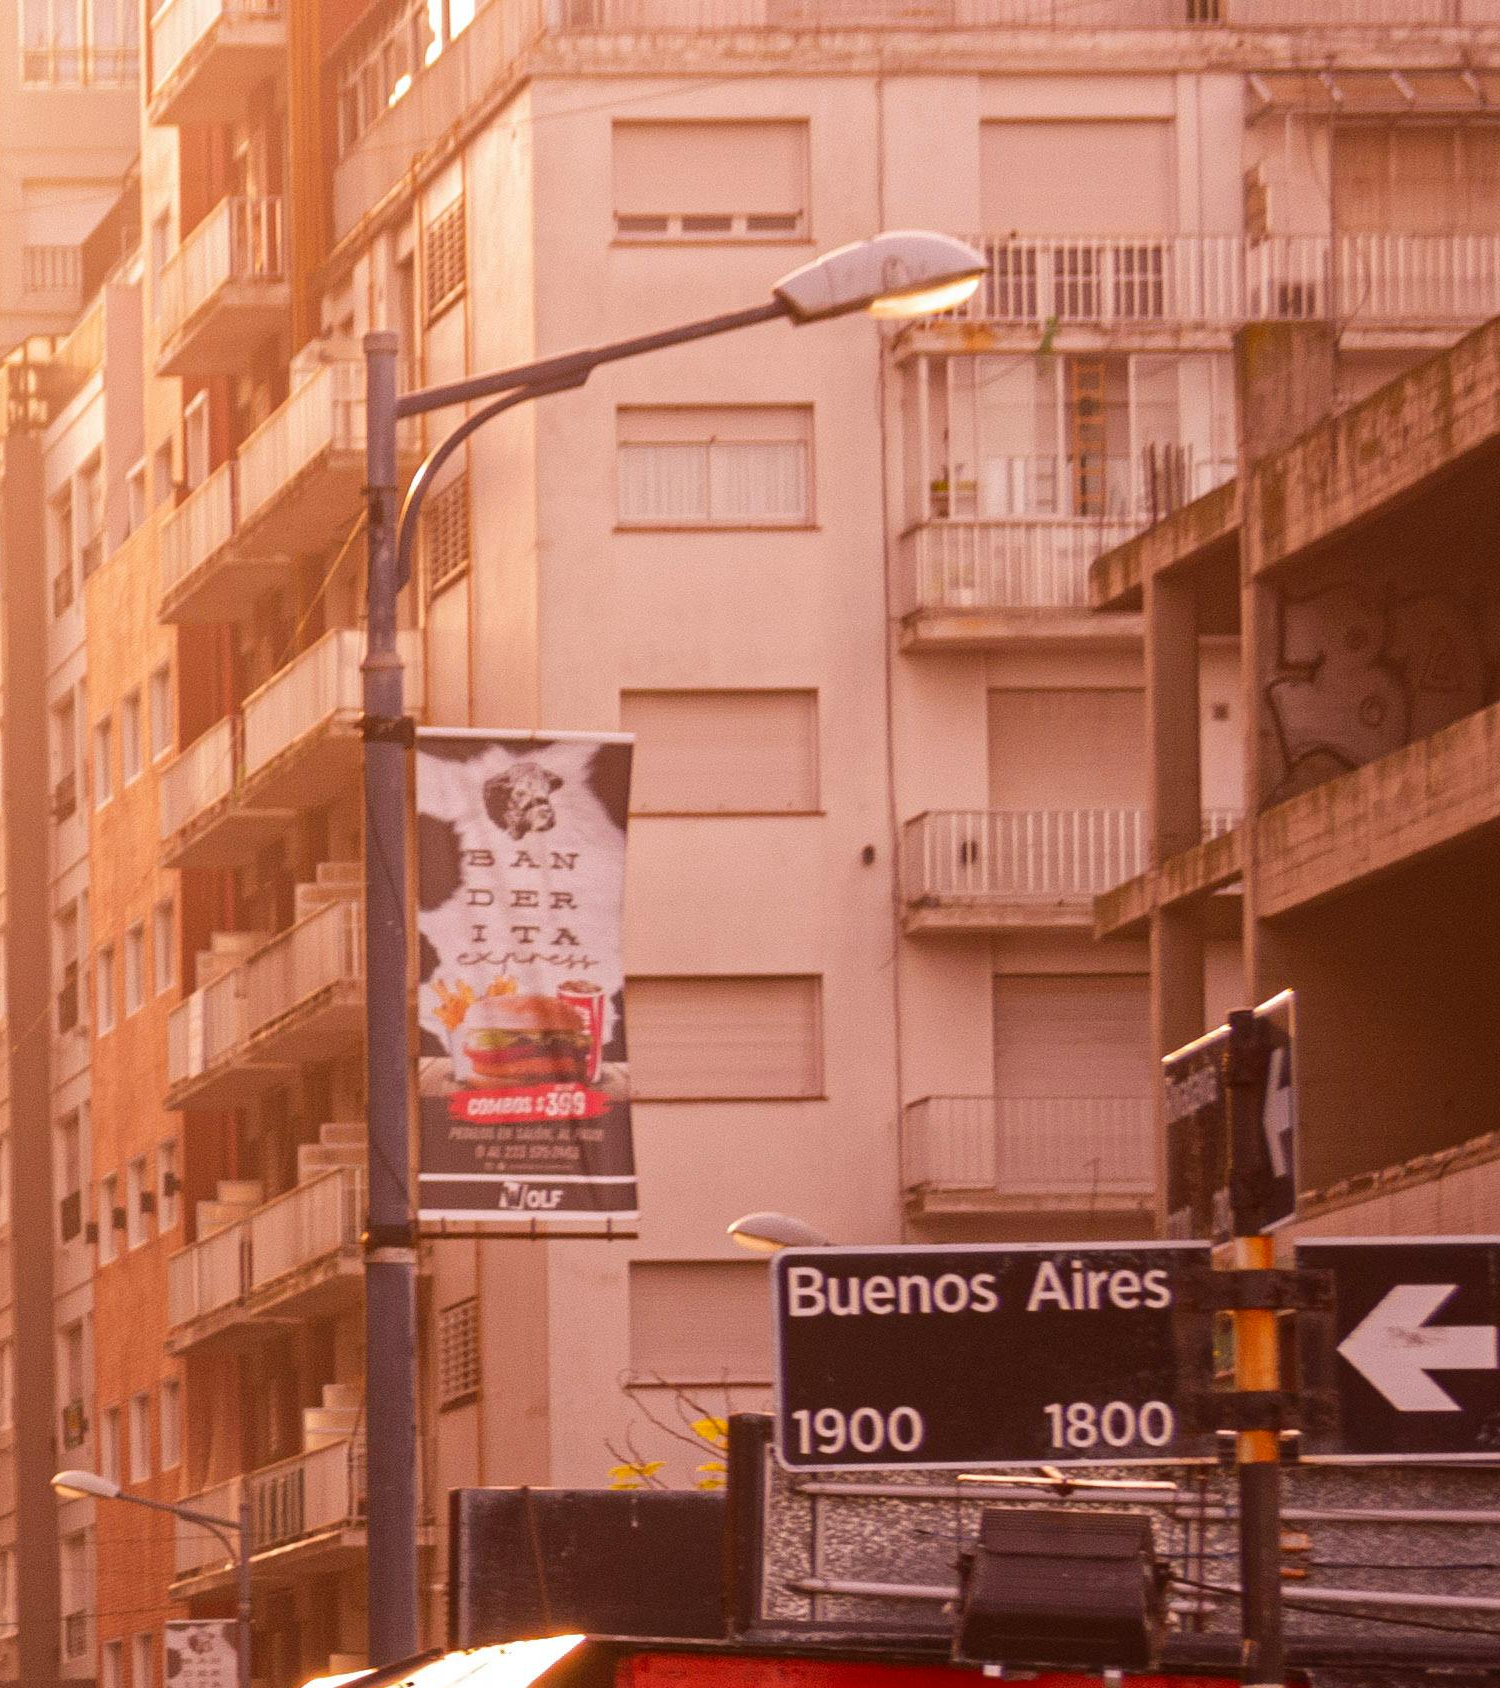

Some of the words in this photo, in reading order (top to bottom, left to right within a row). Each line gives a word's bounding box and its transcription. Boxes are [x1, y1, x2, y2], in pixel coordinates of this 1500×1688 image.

[787, 1267, 998, 1317] Buenos
[1027, 1260, 1171, 1312] Aires
[792, 1406, 923, 1455] 1900
[1044, 1401, 1175, 1449] 1800
